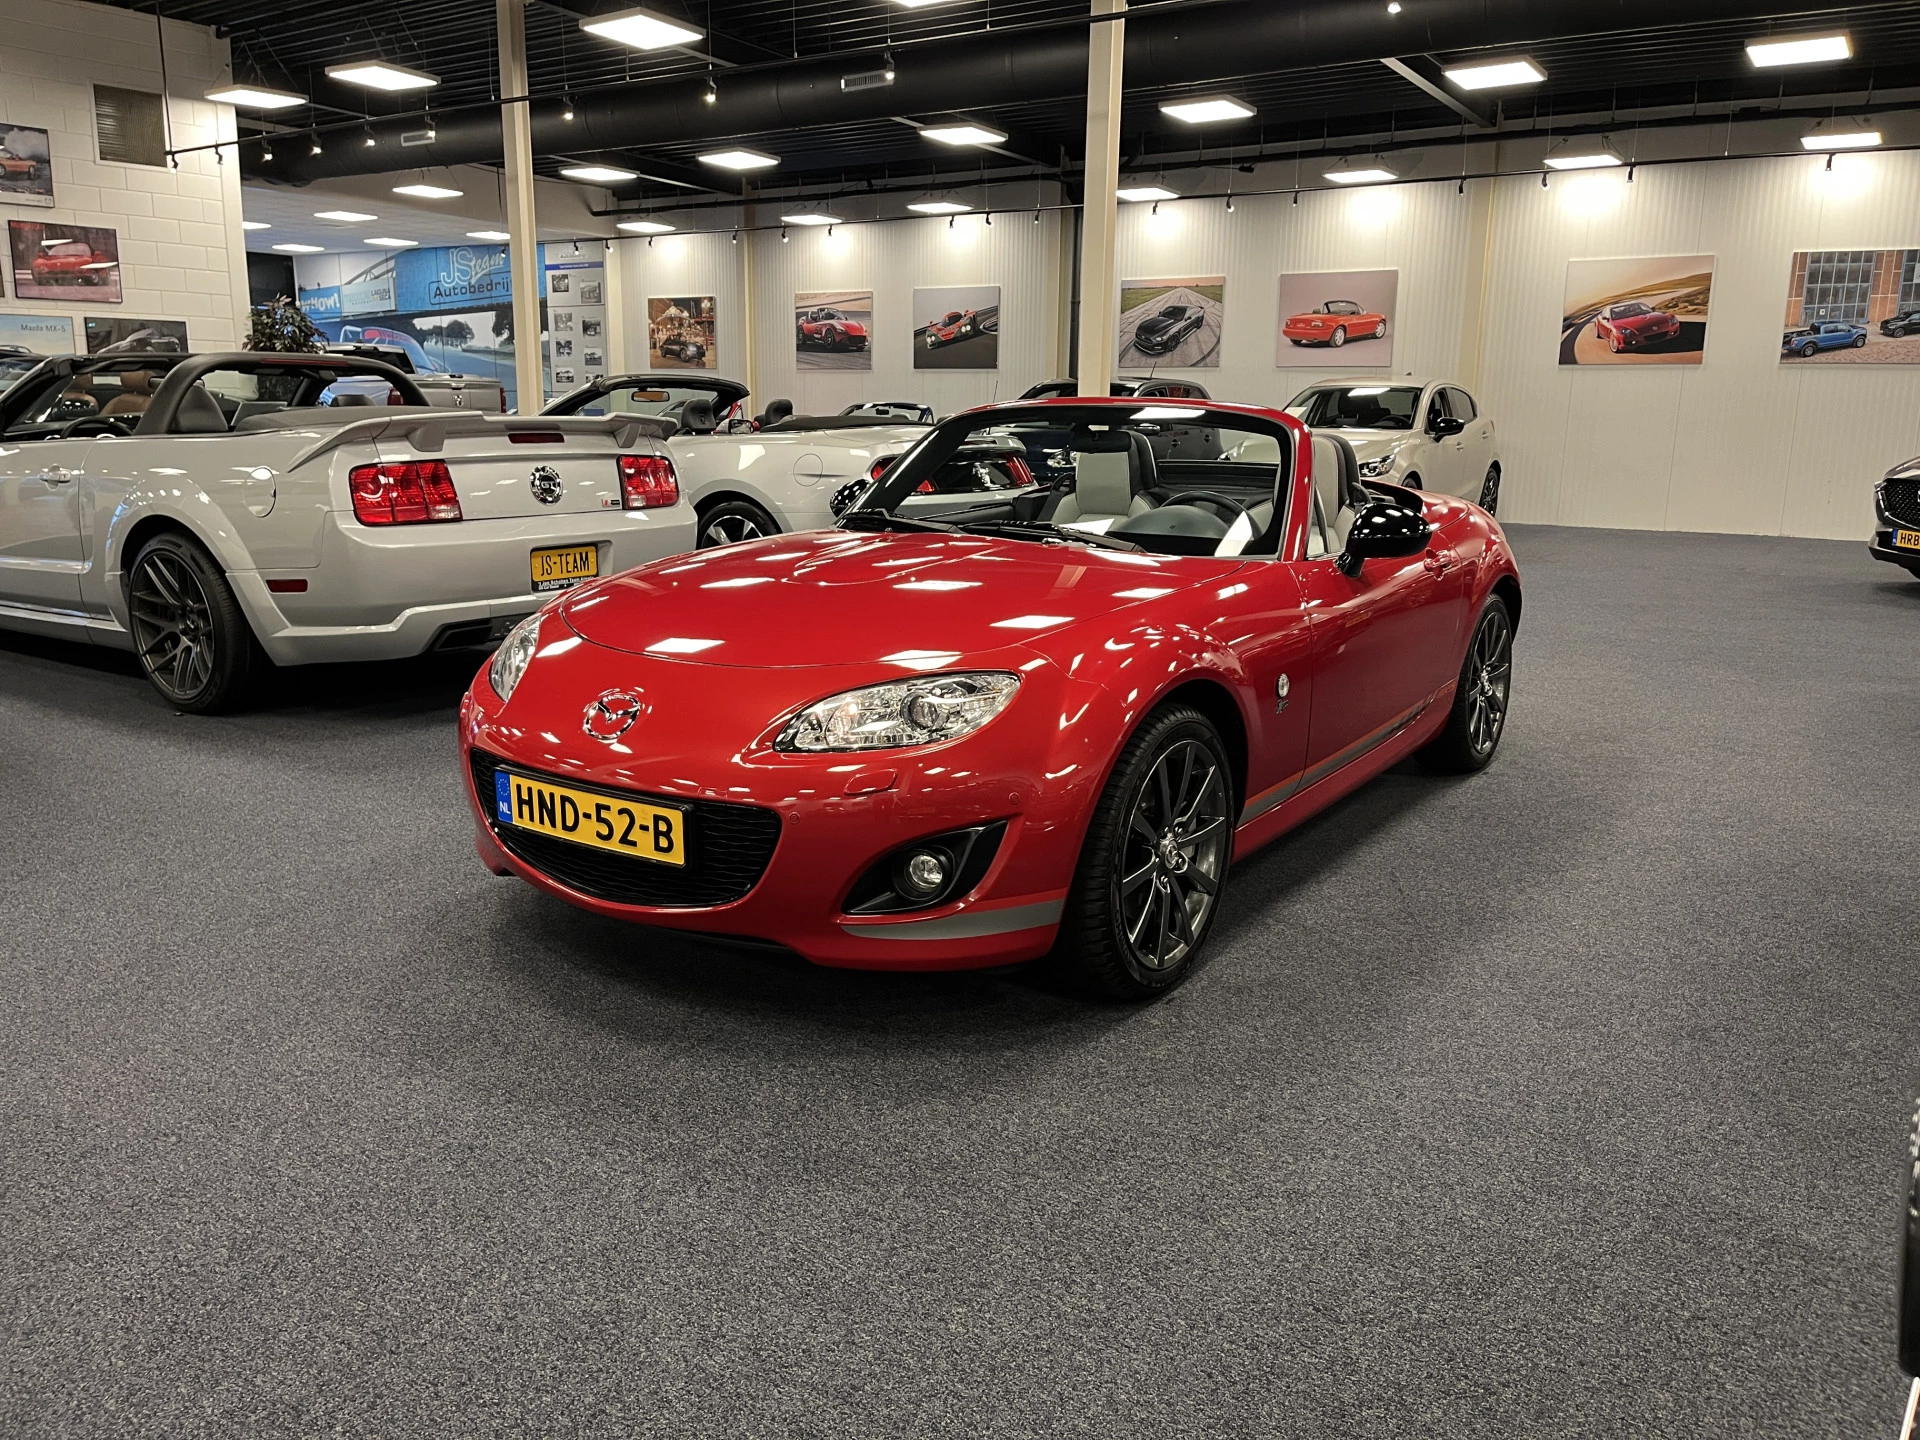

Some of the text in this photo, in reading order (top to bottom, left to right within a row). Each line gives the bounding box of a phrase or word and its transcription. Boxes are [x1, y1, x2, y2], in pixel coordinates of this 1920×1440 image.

[21, 324, 66, 333] Mazda MX-5
[541, 551, 590, 577] JS-TEAM
[499, 801, 511, 815] NL
[515, 783, 675, 854] HND-52-B
